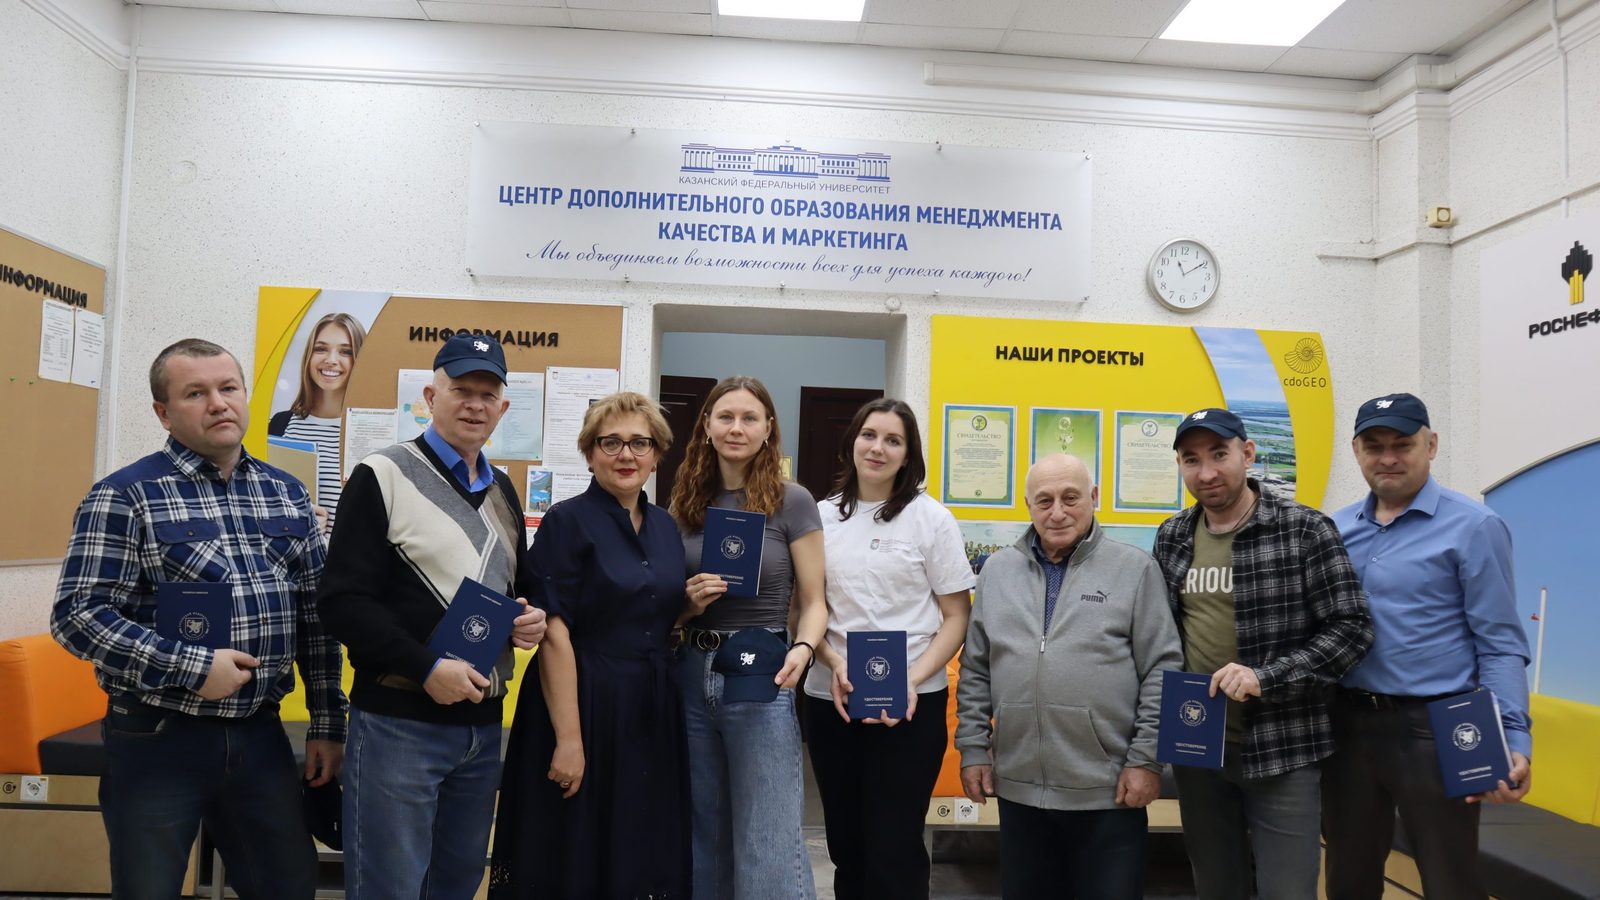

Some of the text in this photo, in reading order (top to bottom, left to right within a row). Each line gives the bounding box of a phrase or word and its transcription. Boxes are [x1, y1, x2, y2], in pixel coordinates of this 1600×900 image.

[679, 176, 891, 194] КАЗАНСКИЙ ФЕДЕРАЛЬНЫЙ УНИВЕРСИТЕТ
[499, 185, 1063, 230] ЦЕНТР ДОПОЛНИТЕЛЬНОГО ОБРАЗОВАНИЯ МЕНЕДЖМЕНТА
[658, 222, 908, 251] КАЧЕСТВА И МАРКЕТИНГА
[526, 239, 1033, 289] Мы объединяем возможности всех для успеха каждого!
[995, 345, 1144, 367] НАШИ ПРОЕКТЫ
[1283, 376, 1327, 388] cdoGEO
[1081, 594, 1104, 604] PUMA
